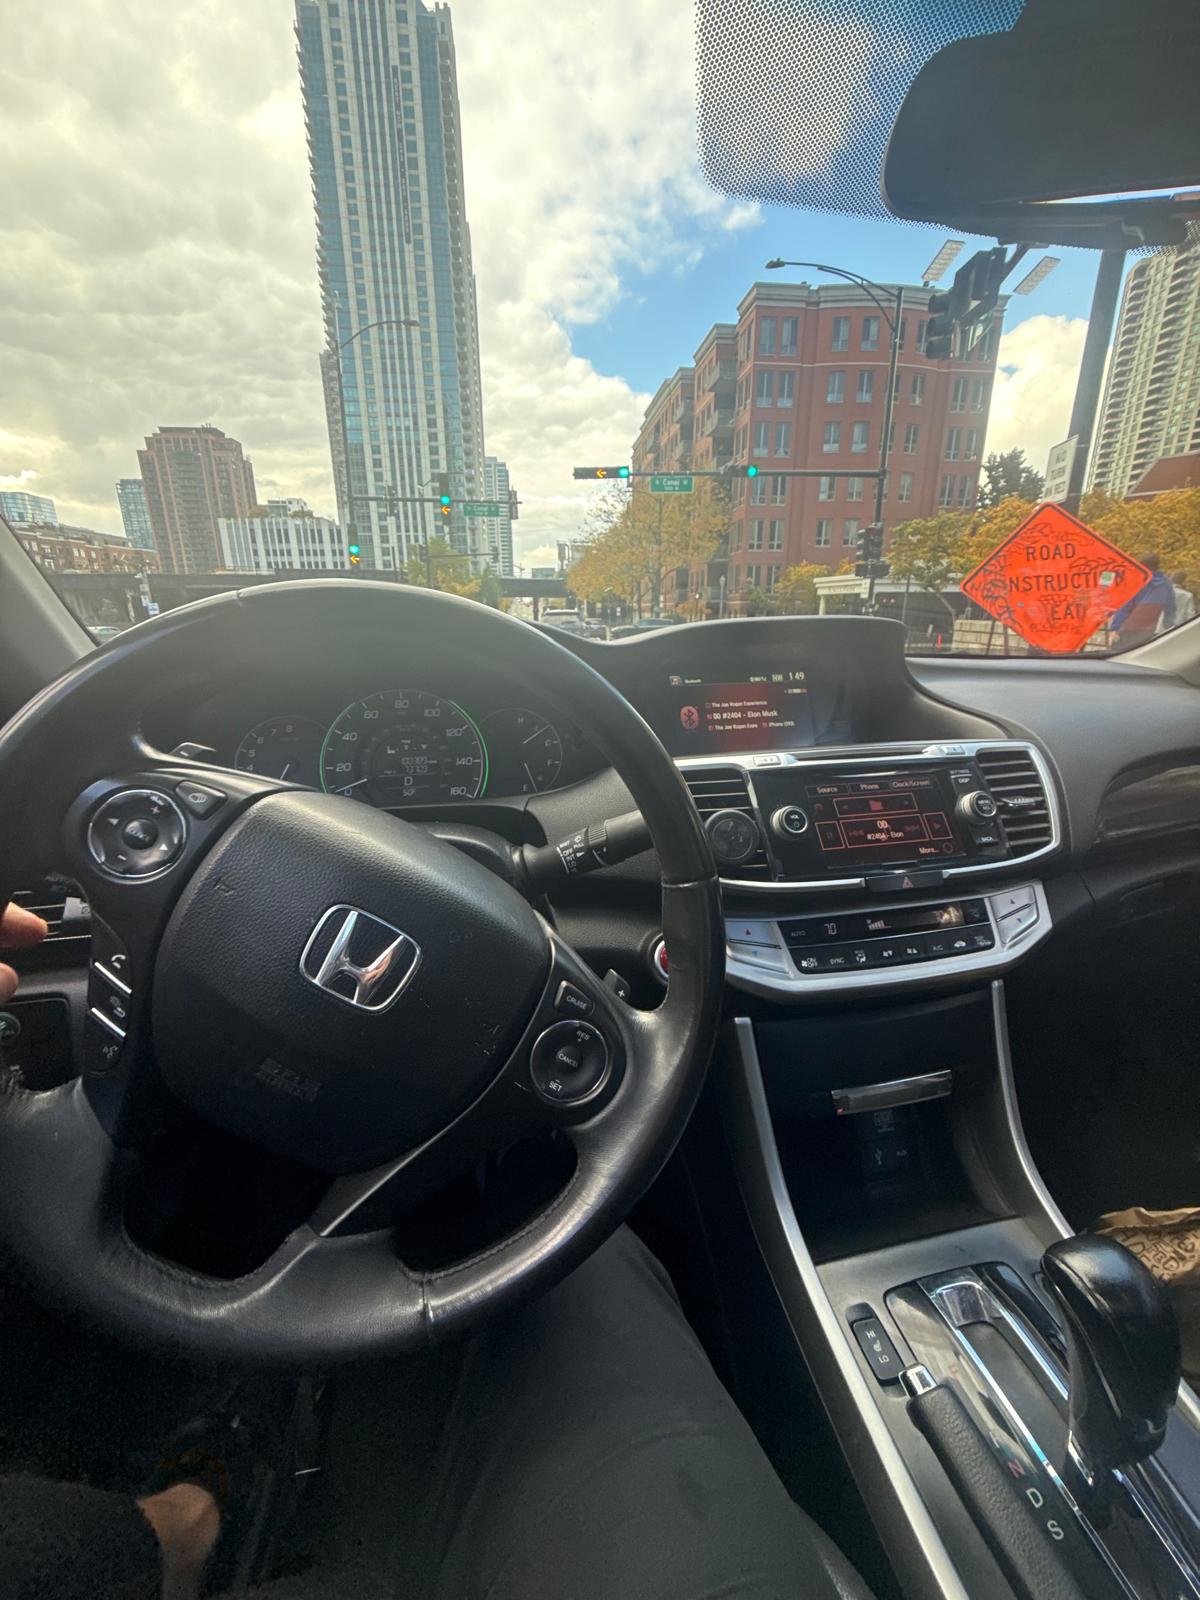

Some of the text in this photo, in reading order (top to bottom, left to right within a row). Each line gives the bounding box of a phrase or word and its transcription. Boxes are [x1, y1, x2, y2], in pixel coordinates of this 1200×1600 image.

[1026, 543, 1076, 562] ROAD
[341, 731, 358, 741] 40
[336, 762, 352, 772] 20
[816, 786, 838, 794] Source
[860, 782, 880, 790] Phone
[566, 995, 587, 1010] CRUISE
[549, 1081, 562, 1093] SET
[1007, 1459, 1025, 1479] N
[1025, 1487, 1044, 1509] D
[1046, 1519, 1065, 1541] S
